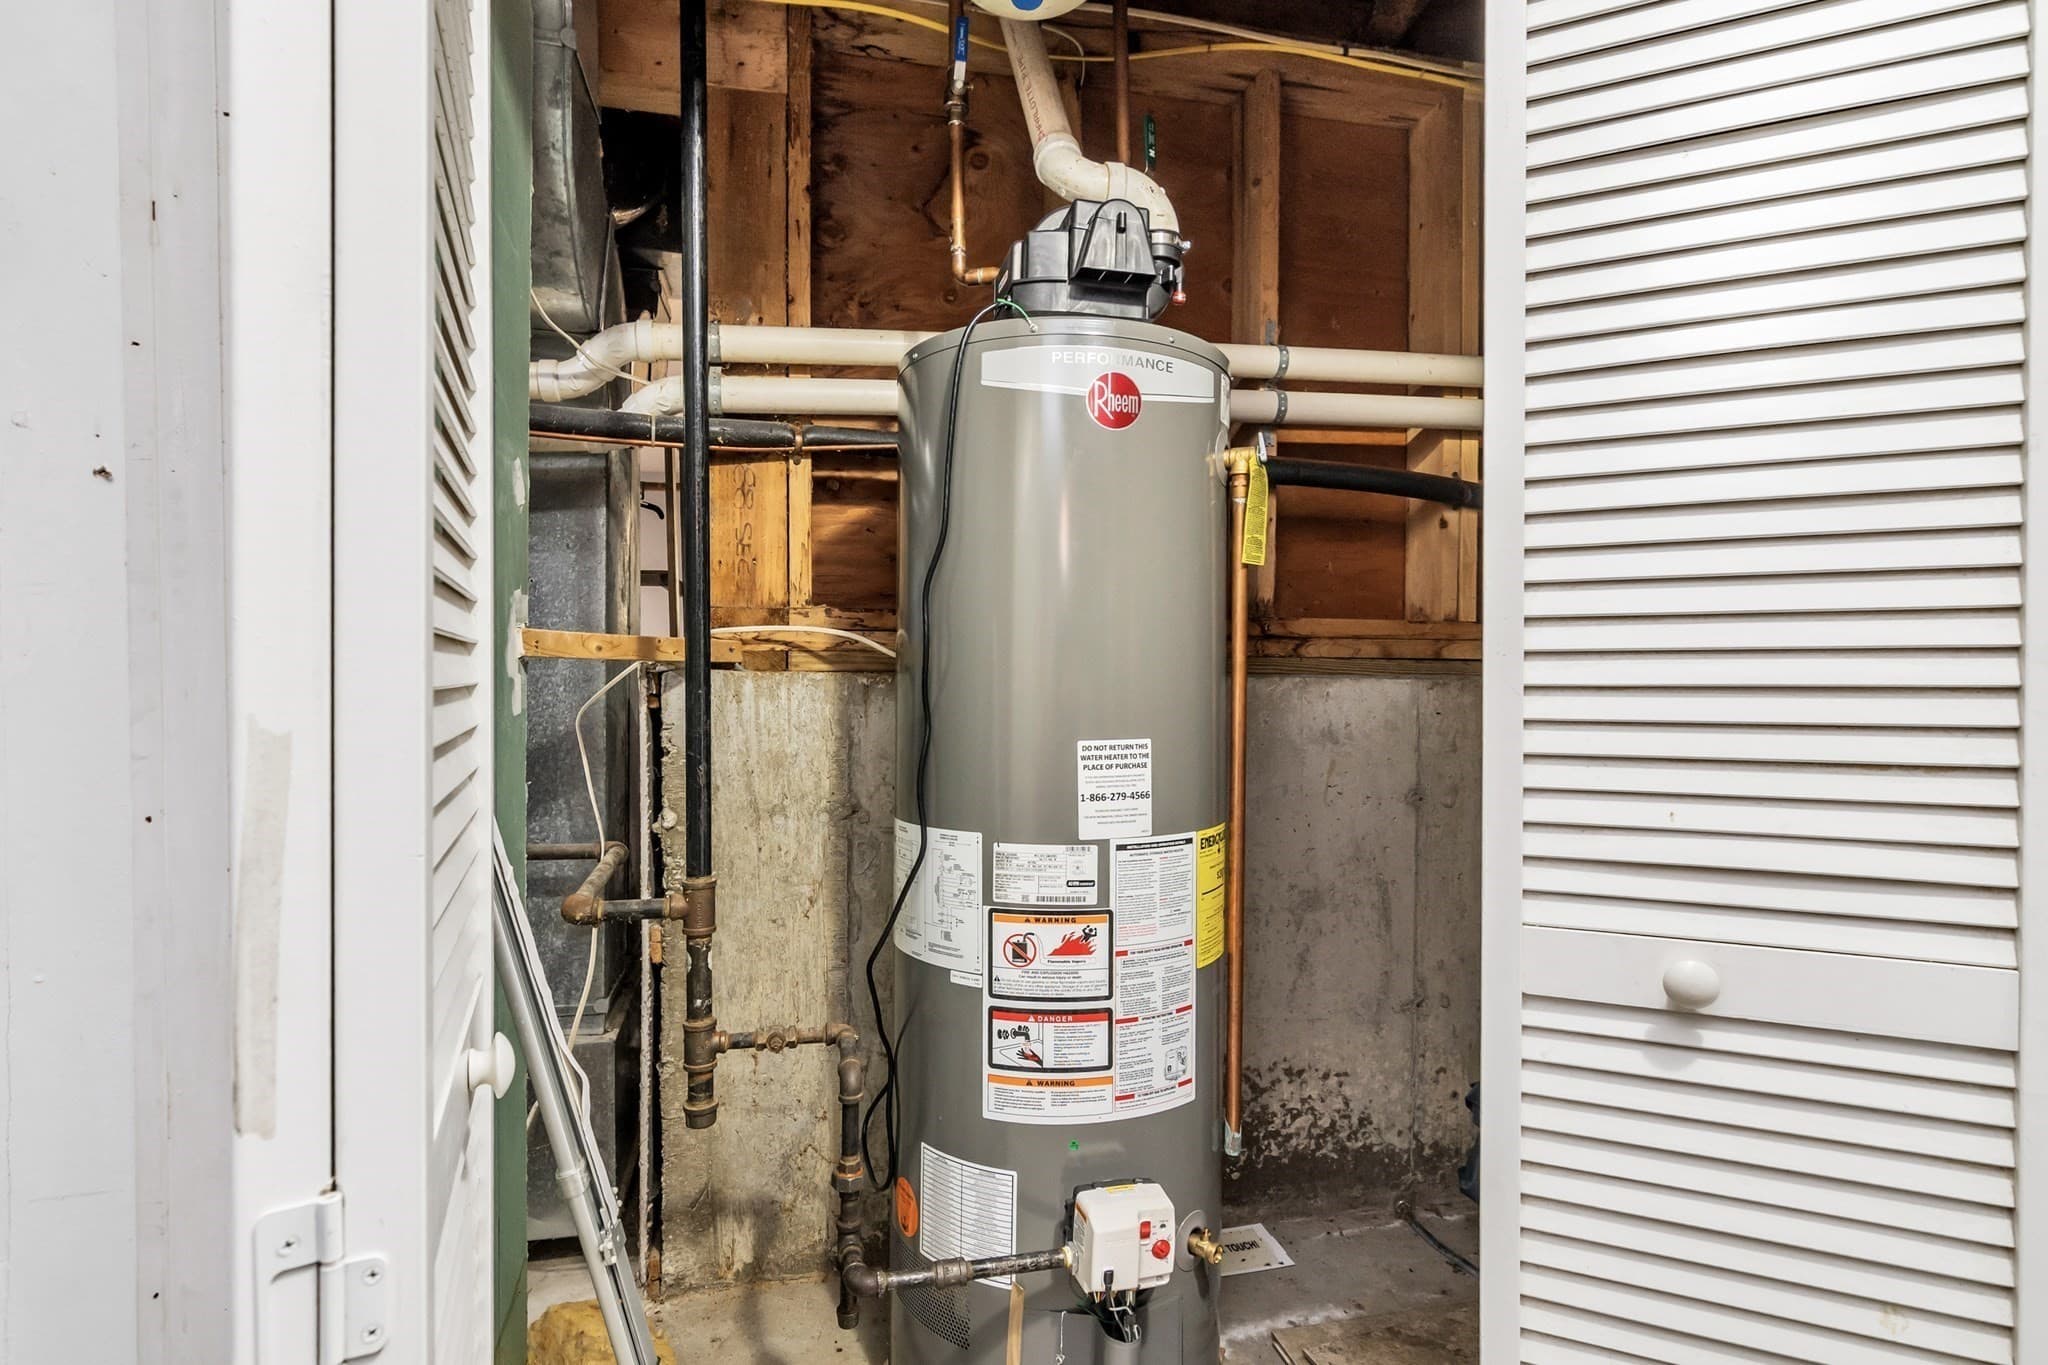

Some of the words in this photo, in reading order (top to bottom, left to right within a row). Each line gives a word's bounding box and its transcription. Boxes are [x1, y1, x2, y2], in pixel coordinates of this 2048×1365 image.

[1051, 351, 1174, 374] PERFOMANCE
[1093, 373, 1140, 420] Rheem
[1080, 790, 1150, 802] 1-866-279-4566
[1224, 1240, 1260, 1252] TOUCH!
